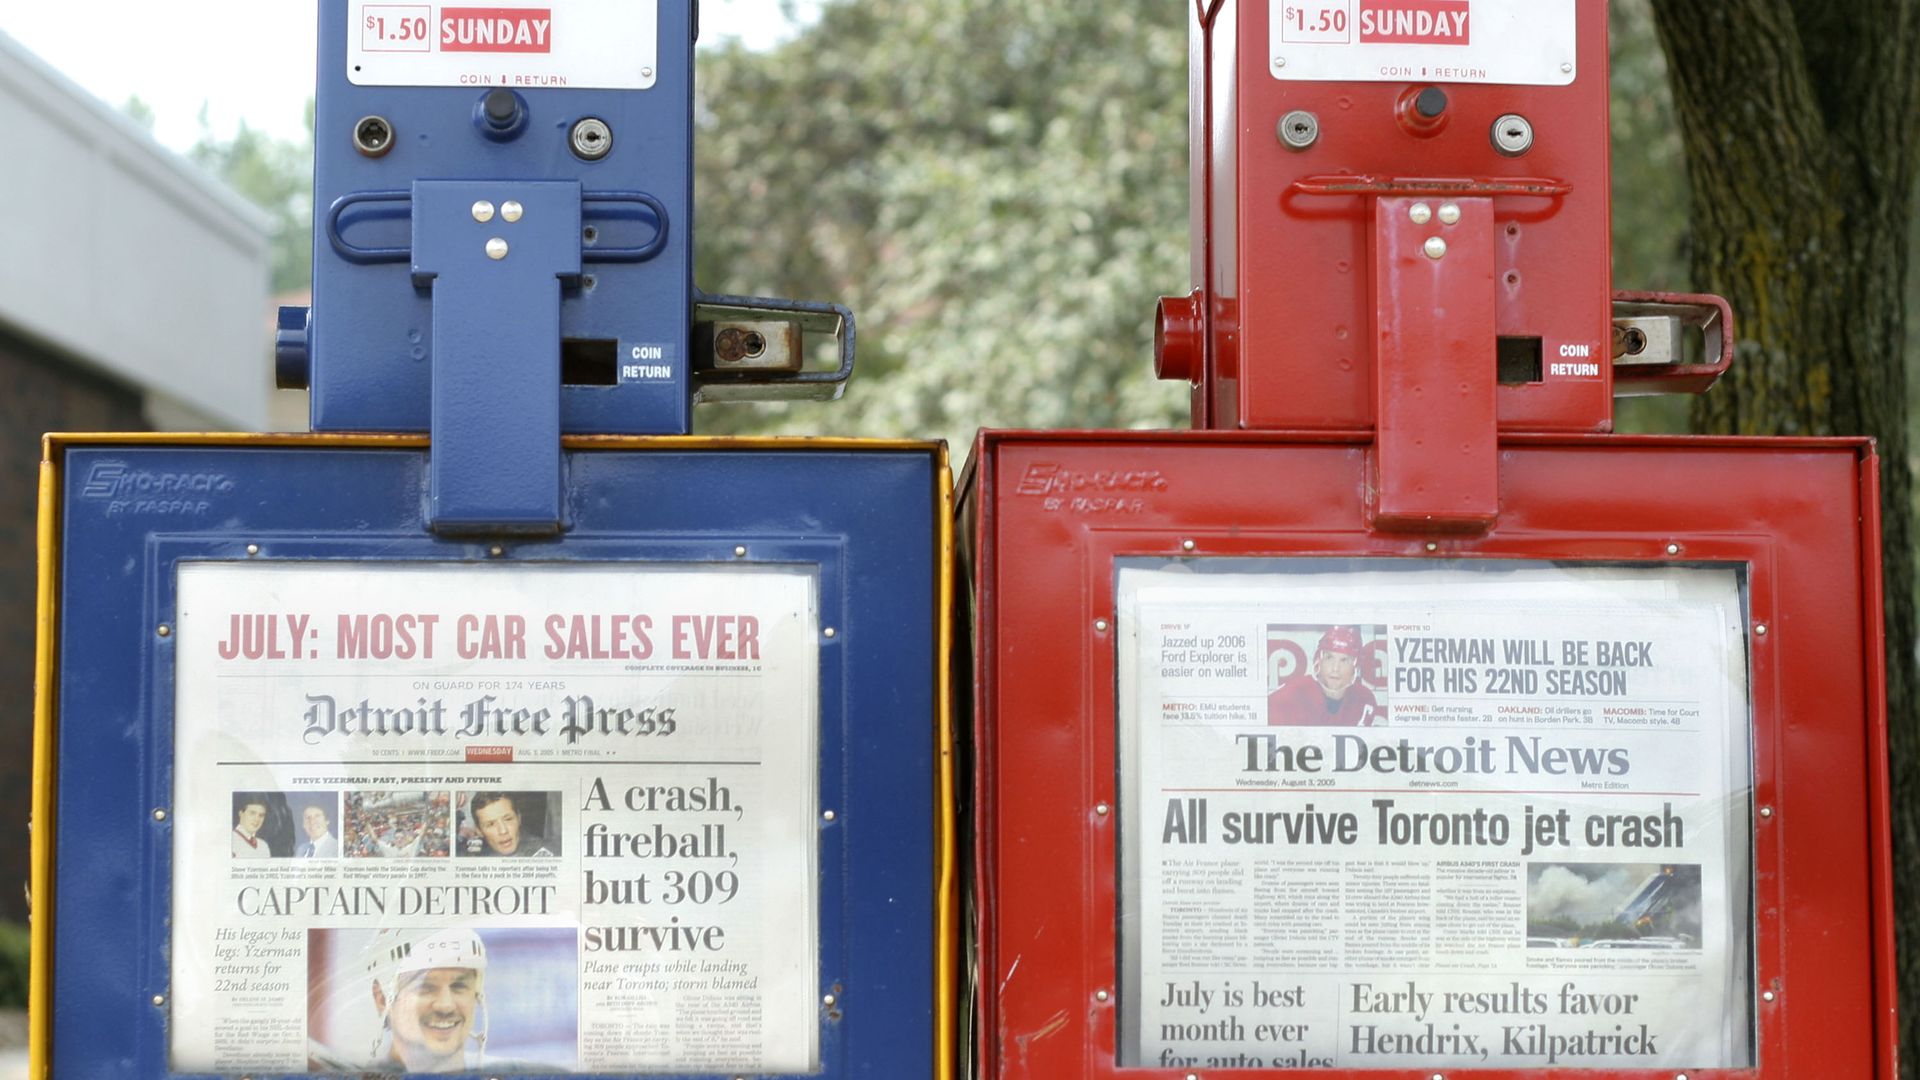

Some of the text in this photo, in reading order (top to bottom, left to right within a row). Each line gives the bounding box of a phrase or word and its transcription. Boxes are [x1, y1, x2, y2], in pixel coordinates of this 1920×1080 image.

[1286, 7, 1345, 32] $1.50
[1362, 9, 1468, 37] SUNDAY
[367, 16, 427, 41] $1.50
[442, 19, 549, 45] SUNDAY
[460, 75, 567, 85] COIN RETURN
[1380, 66, 1486, 78] COIN RETURN
[632, 347, 661, 359] COIN
[1560, 345, 1588, 356] COIN
[623, 366, 670, 378] RETURN
[1551, 364, 1598, 375] RETURN
[218, 614, 760, 660] JULY: MOST CAR SALES EVER
[1161, 636, 1245, 650] Jazzed up 2006
[1161, 650, 1247, 666] Ford Explorer is
[1394, 637, 1653, 667] YZERMAN WILL BE BACK
[1161, 665, 1247, 678] easier on wallet
[413, 682, 565, 690] ON GUARD FOR 174 YEARS
[1395, 667, 1627, 696] FOR HIS 22ND SEASON
[1163, 703, 1250, 711] METRO: EMU students
[1394, 705, 1473, 715] WAYNE: Get nursing
[1497, 706, 1592, 717] OAKLAND: Oil drillers go
[1603, 707, 1700, 717] MACOMB: Time for Court
[303, 693, 676, 745] Detroit Free Press
[1603, 717, 1615, 726] TV,
[1617, 717, 1648, 725] Macomb
[1236, 734, 1630, 776] The Detroit News
[373, 777, 399, 785] PAST,
[1236, 778, 1279, 787] Wednesday,
[1282, 778, 1307, 787] August
[1409, 780, 1458, 788] detnews.com
[1581, 781, 1629, 790] Metro Edition
[582, 777, 743, 821] A crash,
[1162, 798, 1683, 855] All survive Toronto jet crash
[584, 824, 738, 868] fireball,
[584, 870, 738, 905] but 309
[238, 885, 556, 916] CAPTAIN DETROIT
[215, 928, 302, 944] His legacy has
[585, 916, 724, 951] survive
[215, 945, 300, 961] legs: Yzerman
[215, 962, 282, 978] returns for
[584, 960, 747, 977] Plane erupts while landing
[214, 980, 289, 992] 22nd season
[584, 977, 758, 992] near Toronto; storm blamed
[1161, 981, 1305, 1014] July is best
[1351, 982, 1639, 1022] Early results favor
[1161, 1016, 1309, 1042] month ever
[1349, 1023, 1658, 1064] Hendrix, Kilpatrick
